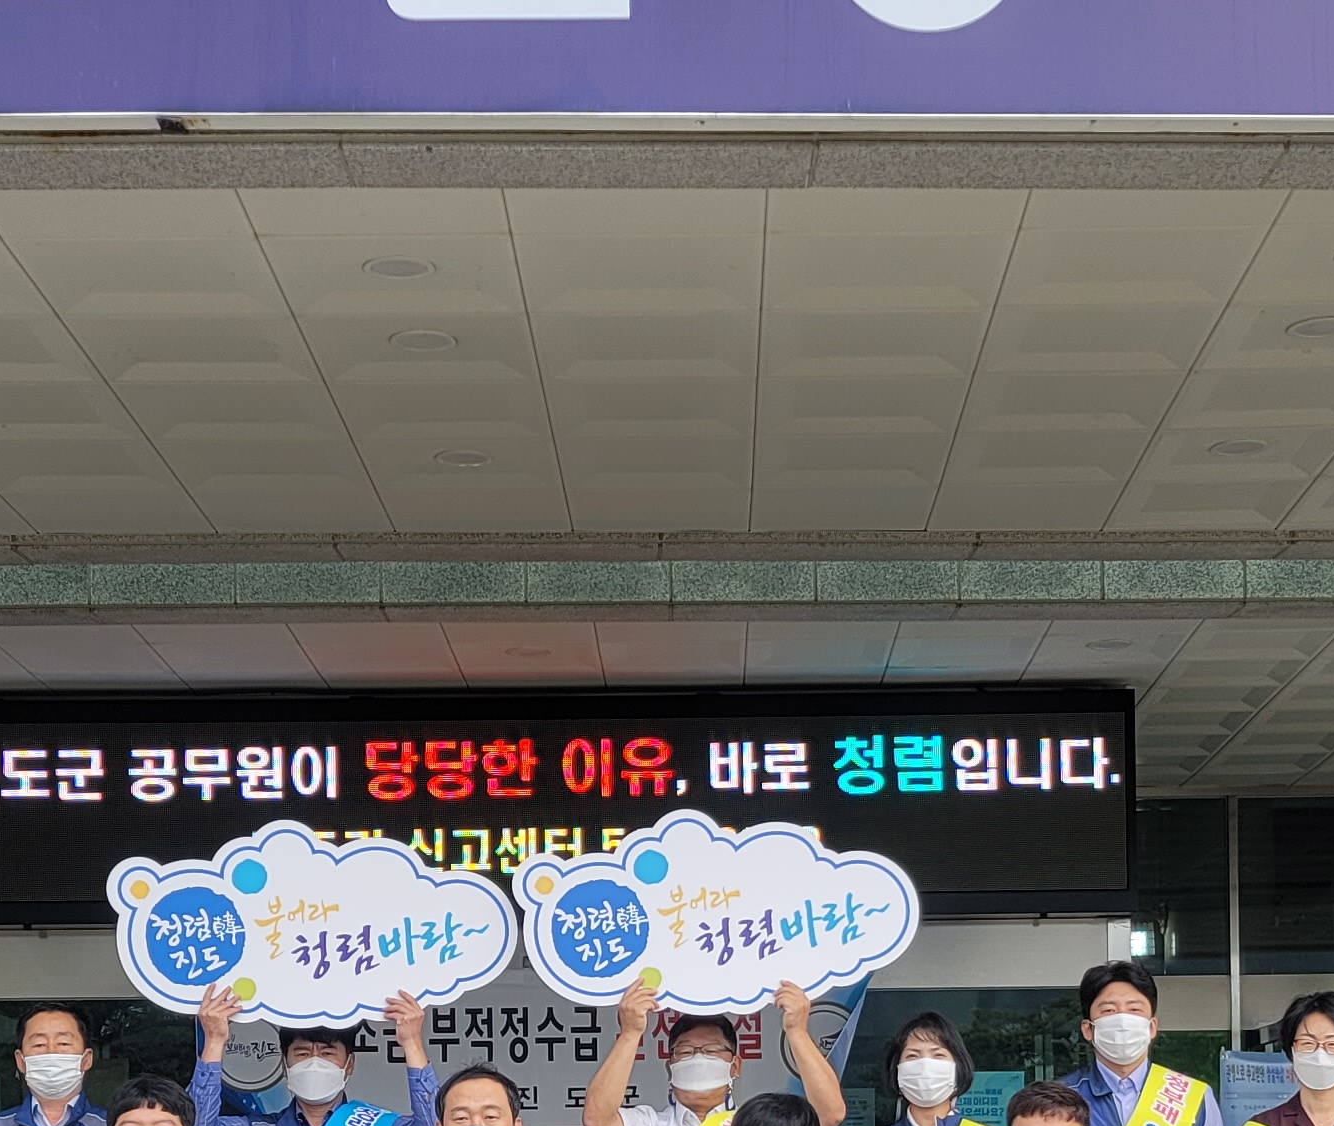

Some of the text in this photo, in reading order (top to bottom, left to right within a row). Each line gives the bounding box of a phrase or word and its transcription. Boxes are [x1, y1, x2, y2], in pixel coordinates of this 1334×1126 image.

[128, 745, 338, 800] 공무원이
[364, 739, 538, 799] 당당한
[561, 737, 687, 798] 이유,
[709, 740, 811, 793] 바로
[833, 735, 1122, 794] 청렴입니다.
[254, 896, 339, 960] 불어라
[657, 885, 740, 949] 불어라
[169, 945, 227, 979] 진도
[575, 936, 632, 971] 진도
[429, 1006, 601, 1064] 부적정수급
[1153, 1074, 1189, 1125] 정부패
